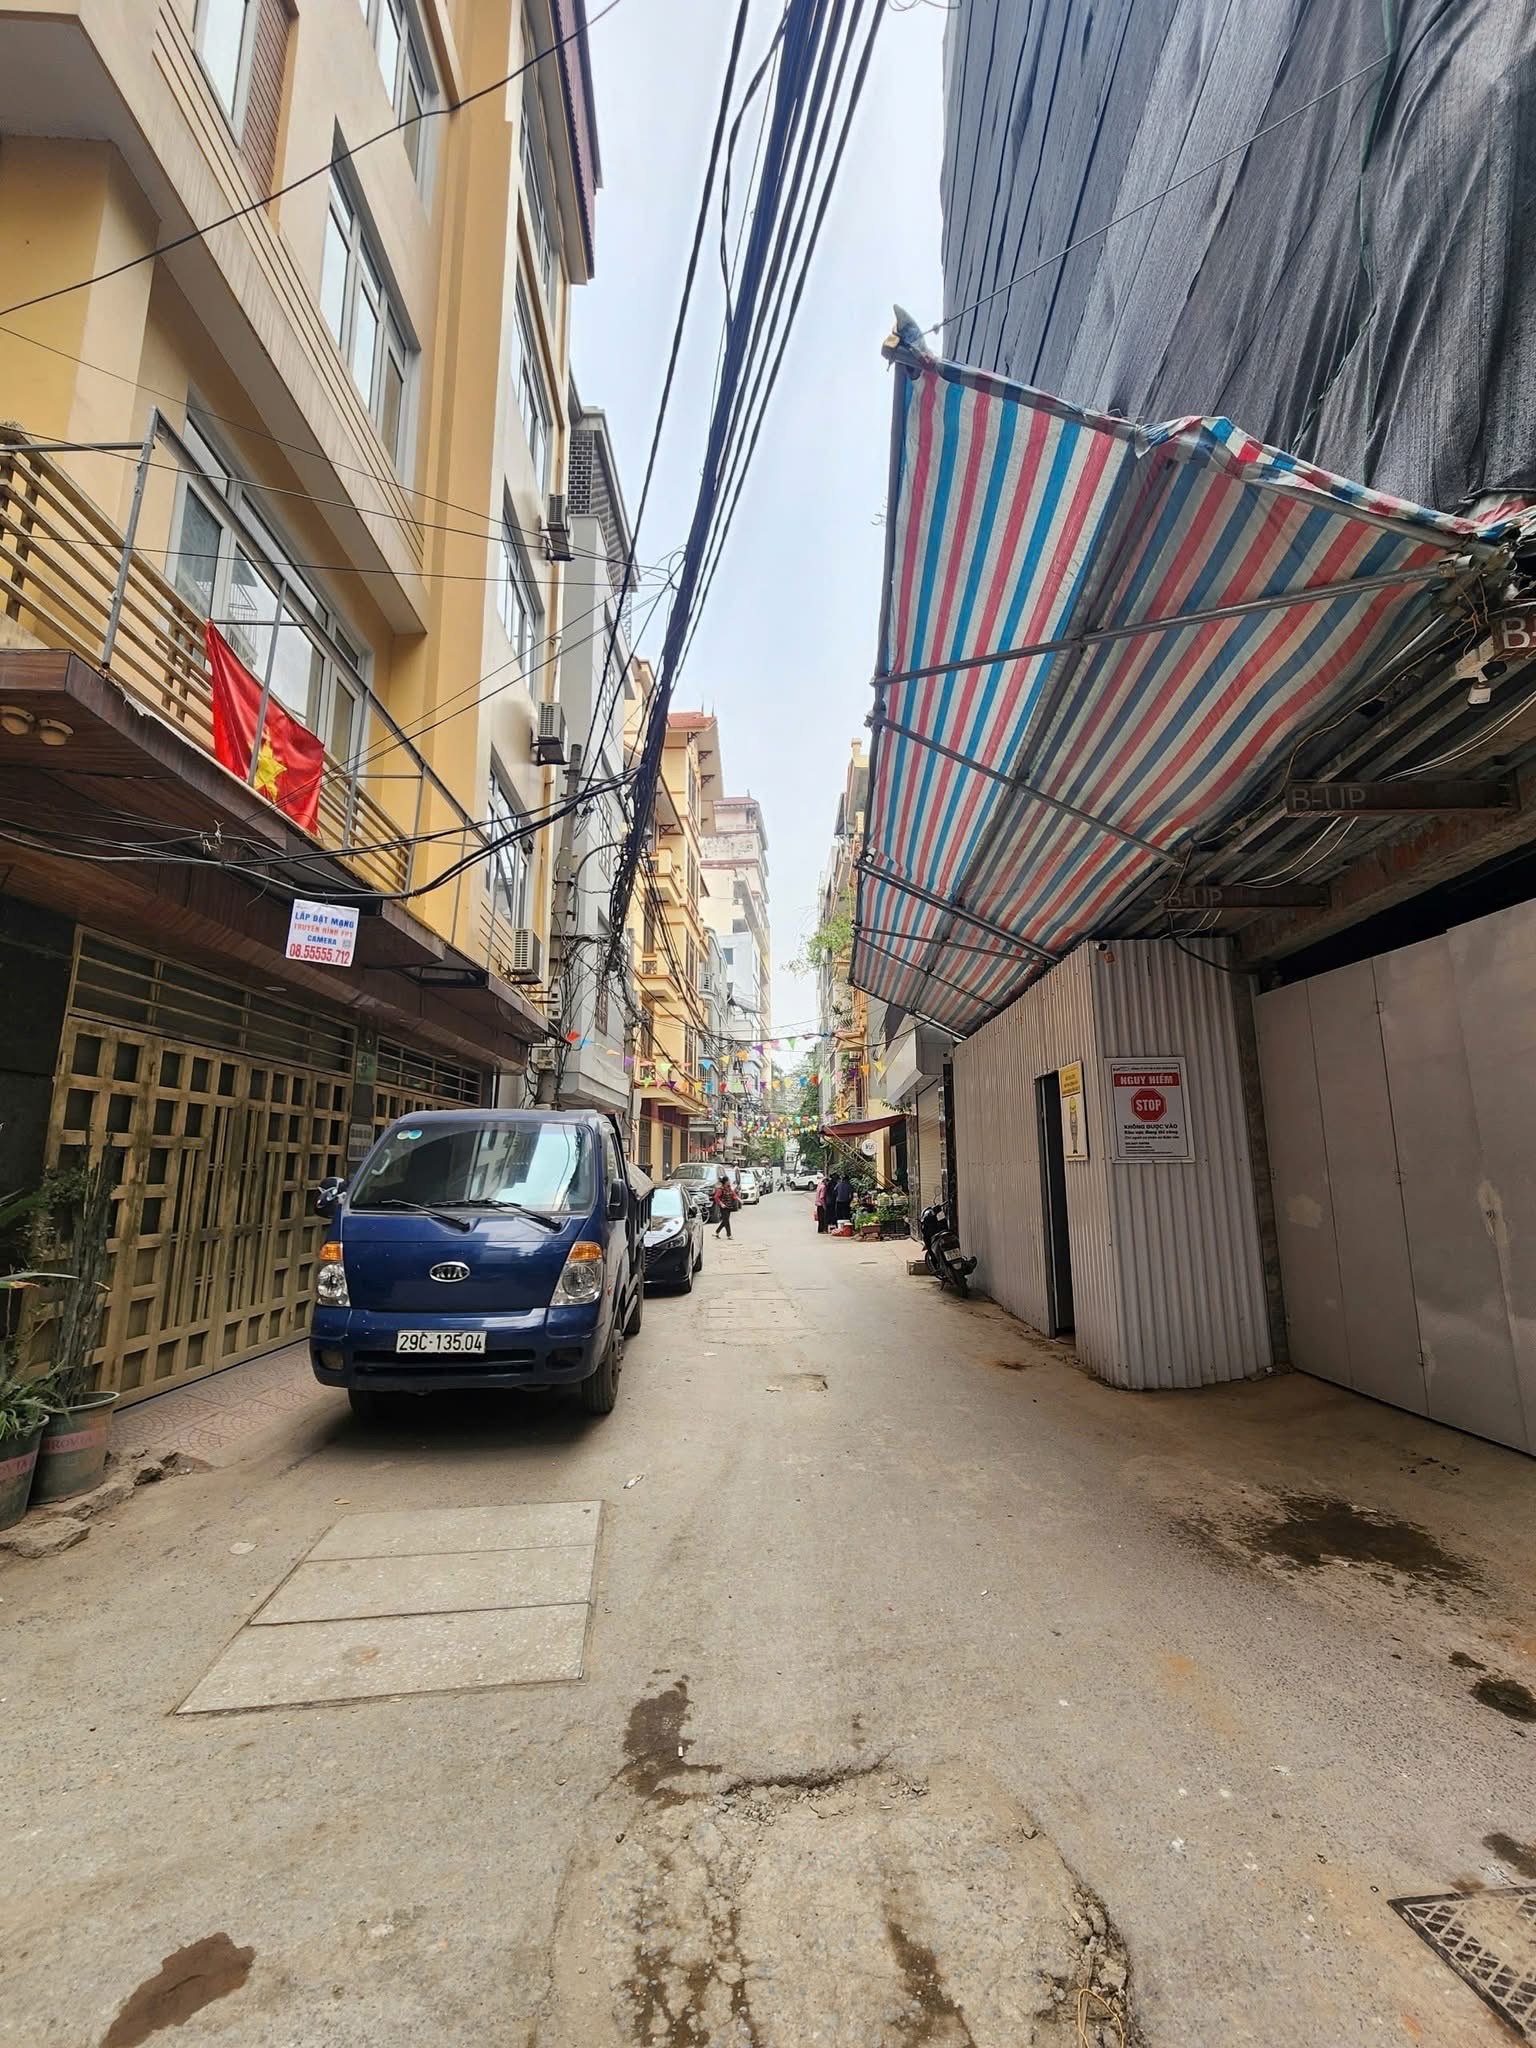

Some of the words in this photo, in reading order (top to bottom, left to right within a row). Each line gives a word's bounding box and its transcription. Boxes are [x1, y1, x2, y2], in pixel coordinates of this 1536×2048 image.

[1501, 616, 1536, 649] B
[1292, 787, 1366, 810] B-UP
[307, 935, 337, 945] CAMERA
[290, 943, 350, 965] 08.55555.712
[1121, 1076, 1146, 1085] NGUY
[1136, 1100, 1162, 1111] STOP
[433, 1266, 464, 1279] KIA
[398, 1333, 483, 1352] 29C-135.04
